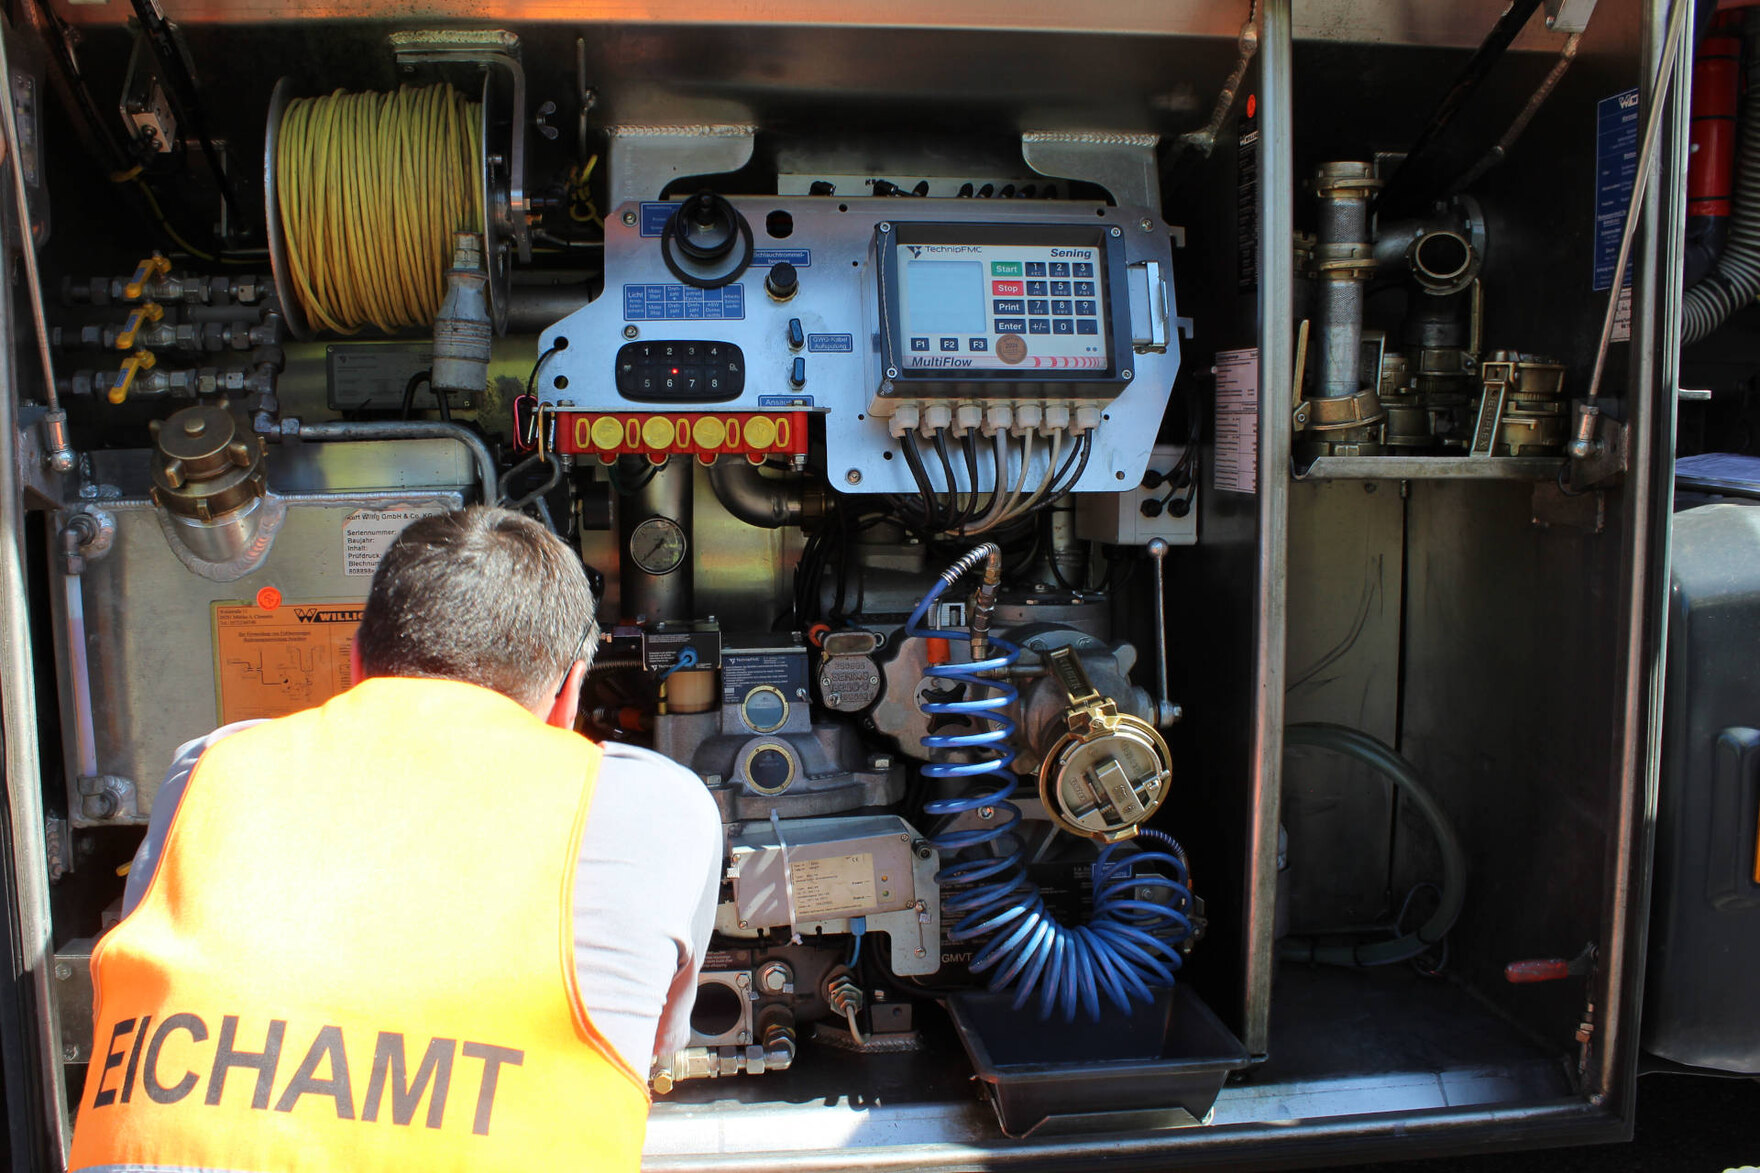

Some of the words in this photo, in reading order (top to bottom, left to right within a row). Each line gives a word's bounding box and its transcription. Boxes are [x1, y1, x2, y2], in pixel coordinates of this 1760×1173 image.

[924, 245, 982, 254] TechnipFMC
[1050, 248, 1092, 260] Sening
[996, 265, 1018, 273] Start
[1056, 263, 1063, 271] 2
[1080, 263, 1086, 271] 3
[998, 284, 1019, 293] Stop
[1058, 282, 1064, 290] 5
[998, 303, 1020, 311] Print
[998, 322, 1022, 330] Enter
[1060, 322, 1067, 331] 0
[973, 341, 984, 349] F3
[644, 347, 649, 355] 1
[666, 347, 673, 355] 2
[688, 347, 695, 355] 3
[711, 347, 717, 355] 4
[912, 356, 972, 367] MultiFlow
[644, 379, 651, 388] 5
[666, 379, 673, 388] 6
[689, 379, 696, 388] 7
[711, 379, 718, 388] 8
[347, 537, 375, 545] Baujahr:
[942, 954, 973, 964] GMVT
[93, 1013, 524, 1136] EICHAMT
